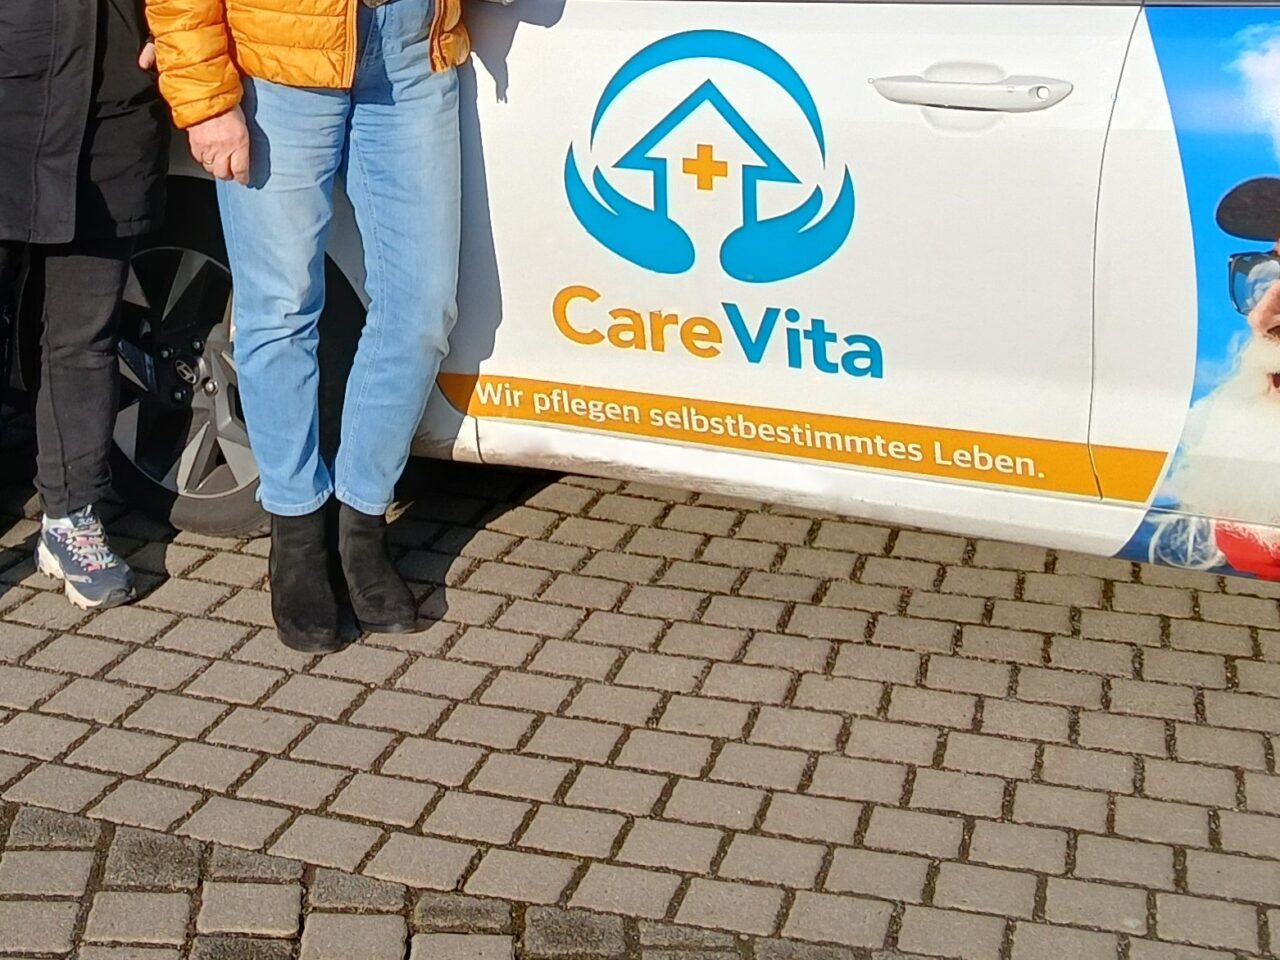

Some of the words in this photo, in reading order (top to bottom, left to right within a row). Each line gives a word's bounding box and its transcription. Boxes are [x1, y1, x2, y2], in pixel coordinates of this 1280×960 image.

[552, 285, 884, 379] CareVita
[475, 382, 524, 408] Wir
[533, 388, 640, 423] pflegen
[649, 405, 923, 462] selbstbestimmtes
[933, 441, 1046, 479] Leben.
